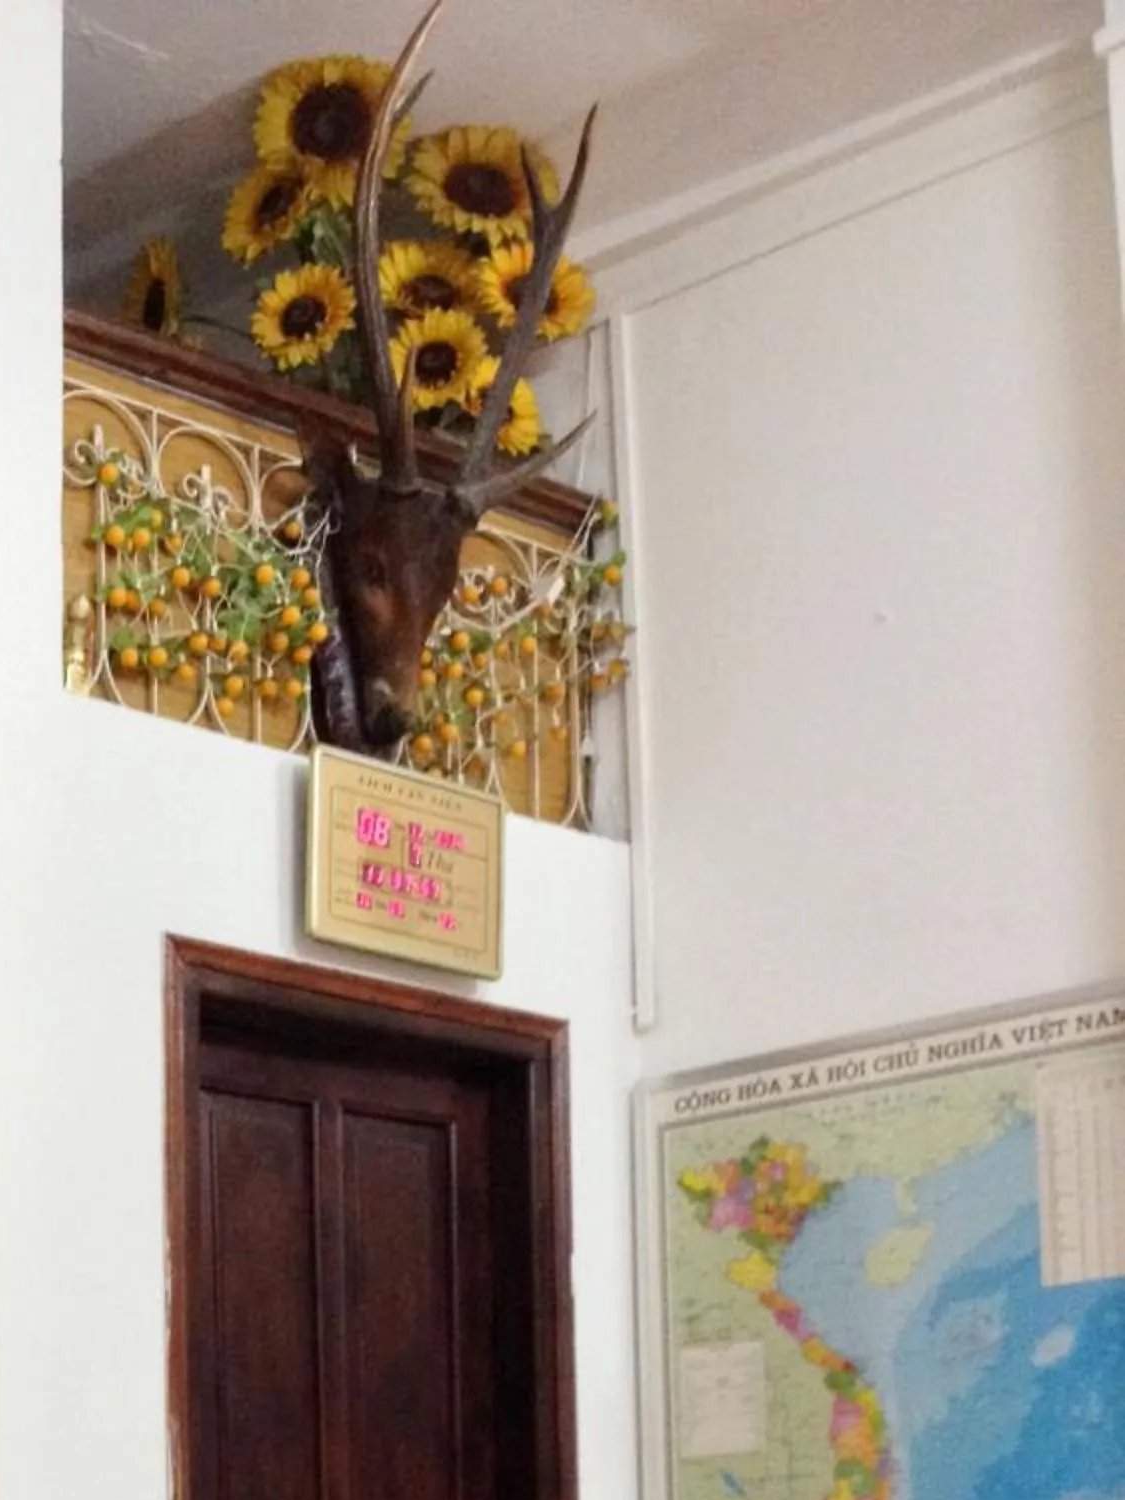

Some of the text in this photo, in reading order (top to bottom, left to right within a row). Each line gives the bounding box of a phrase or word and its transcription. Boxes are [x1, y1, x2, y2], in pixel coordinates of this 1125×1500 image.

[674, 1087, 732, 1115] CỘNG
[737, 1074, 783, 1101] HÒA
[789, 1066, 820, 1090] XÃ
[827, 1060, 866, 1085] HỘI
[873, 1040, 920, 1073] CHỦ
[927, 1031, 1004, 1063] NGHĨA
[1011, 1015, 1069, 1045] VIỆT
